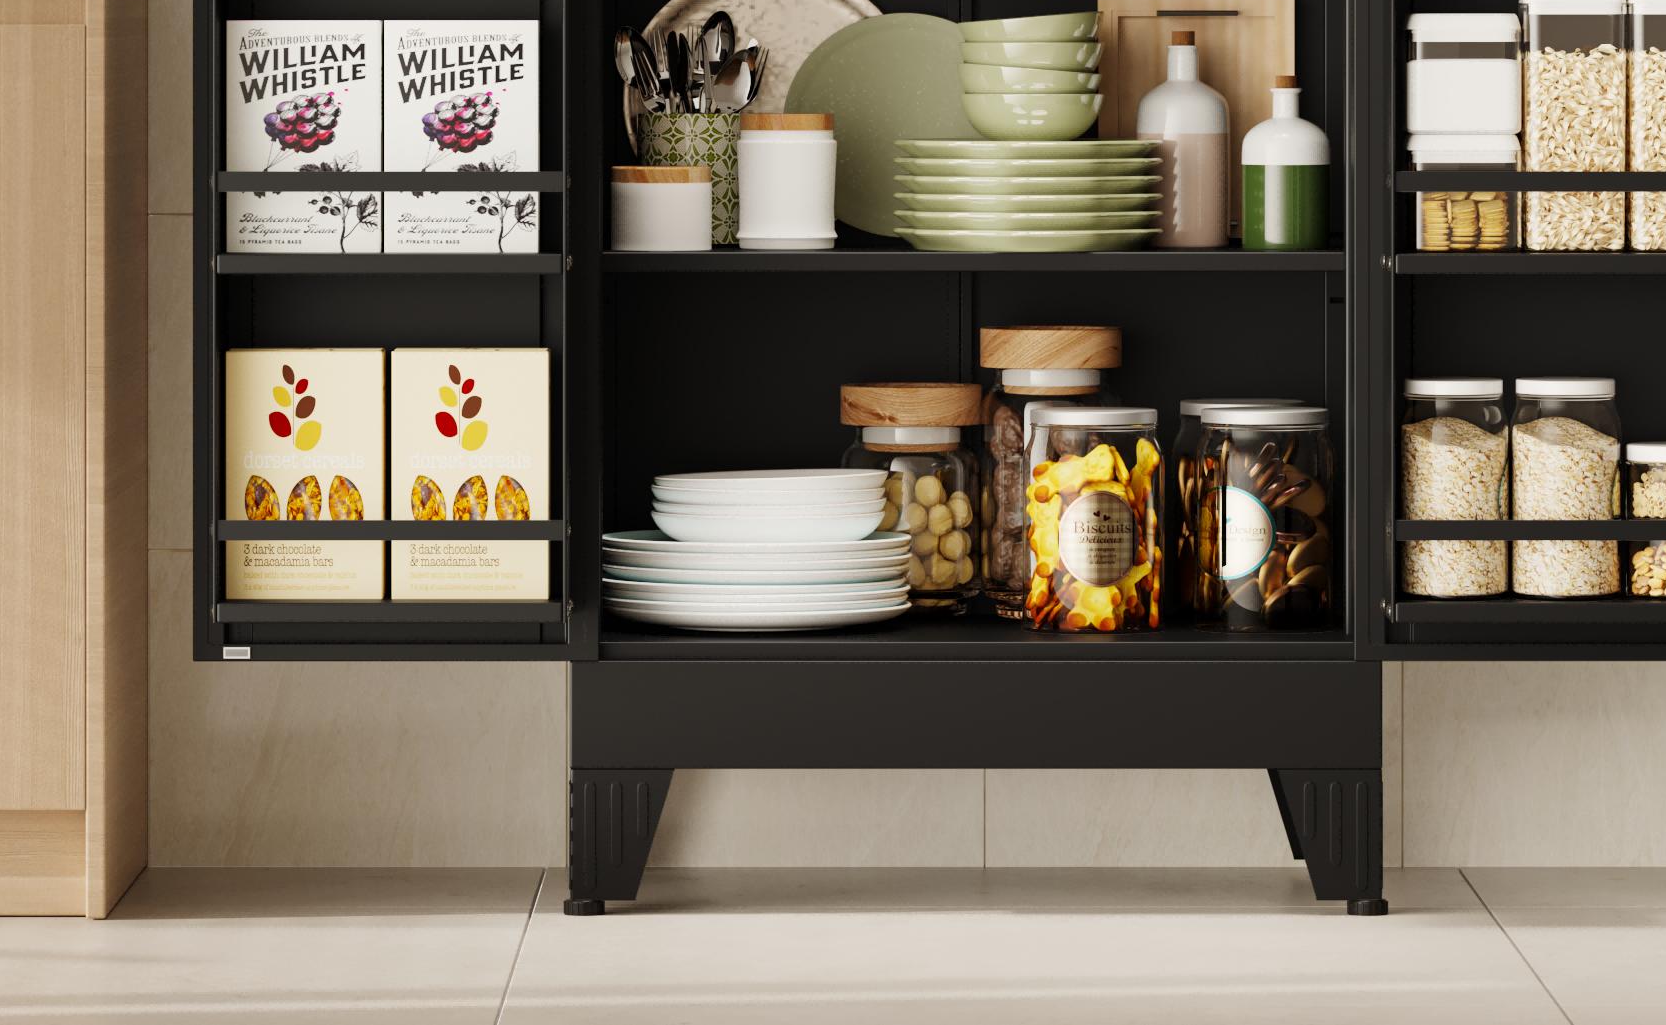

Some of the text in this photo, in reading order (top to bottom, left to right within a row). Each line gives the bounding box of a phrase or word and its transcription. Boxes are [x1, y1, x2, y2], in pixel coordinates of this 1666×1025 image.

[248, 28, 268, 38] The
[406, 28, 425, 38] The
[315, 34, 349, 43] BLENDS
[473, 34, 507, 43] BLENDS
[239, 44, 365, 76] WILLIAM
[397, 44, 523, 76] WILLIAM
[239, 64, 365, 104] WHISTLE
[398, 64, 523, 104] WHISTLE
[239, 213, 314, 223] Blackcurrant
[398, 213, 473, 223] Blackcurrant
[249, 224, 301, 237] Liquorice
[303, 224, 337, 234] Tisane
[407, 224, 459, 237] Liquorice
[461, 224, 495, 234] Tisane
[1073, 520, 1131, 534] Biscuits
[243, 544, 322, 554] 3 dark chocolate
[410, 544, 488, 554] 3 dark chocolate
[243, 556, 333, 566] & macadamia bars
[410, 556, 500, 566] & macadamia bars
